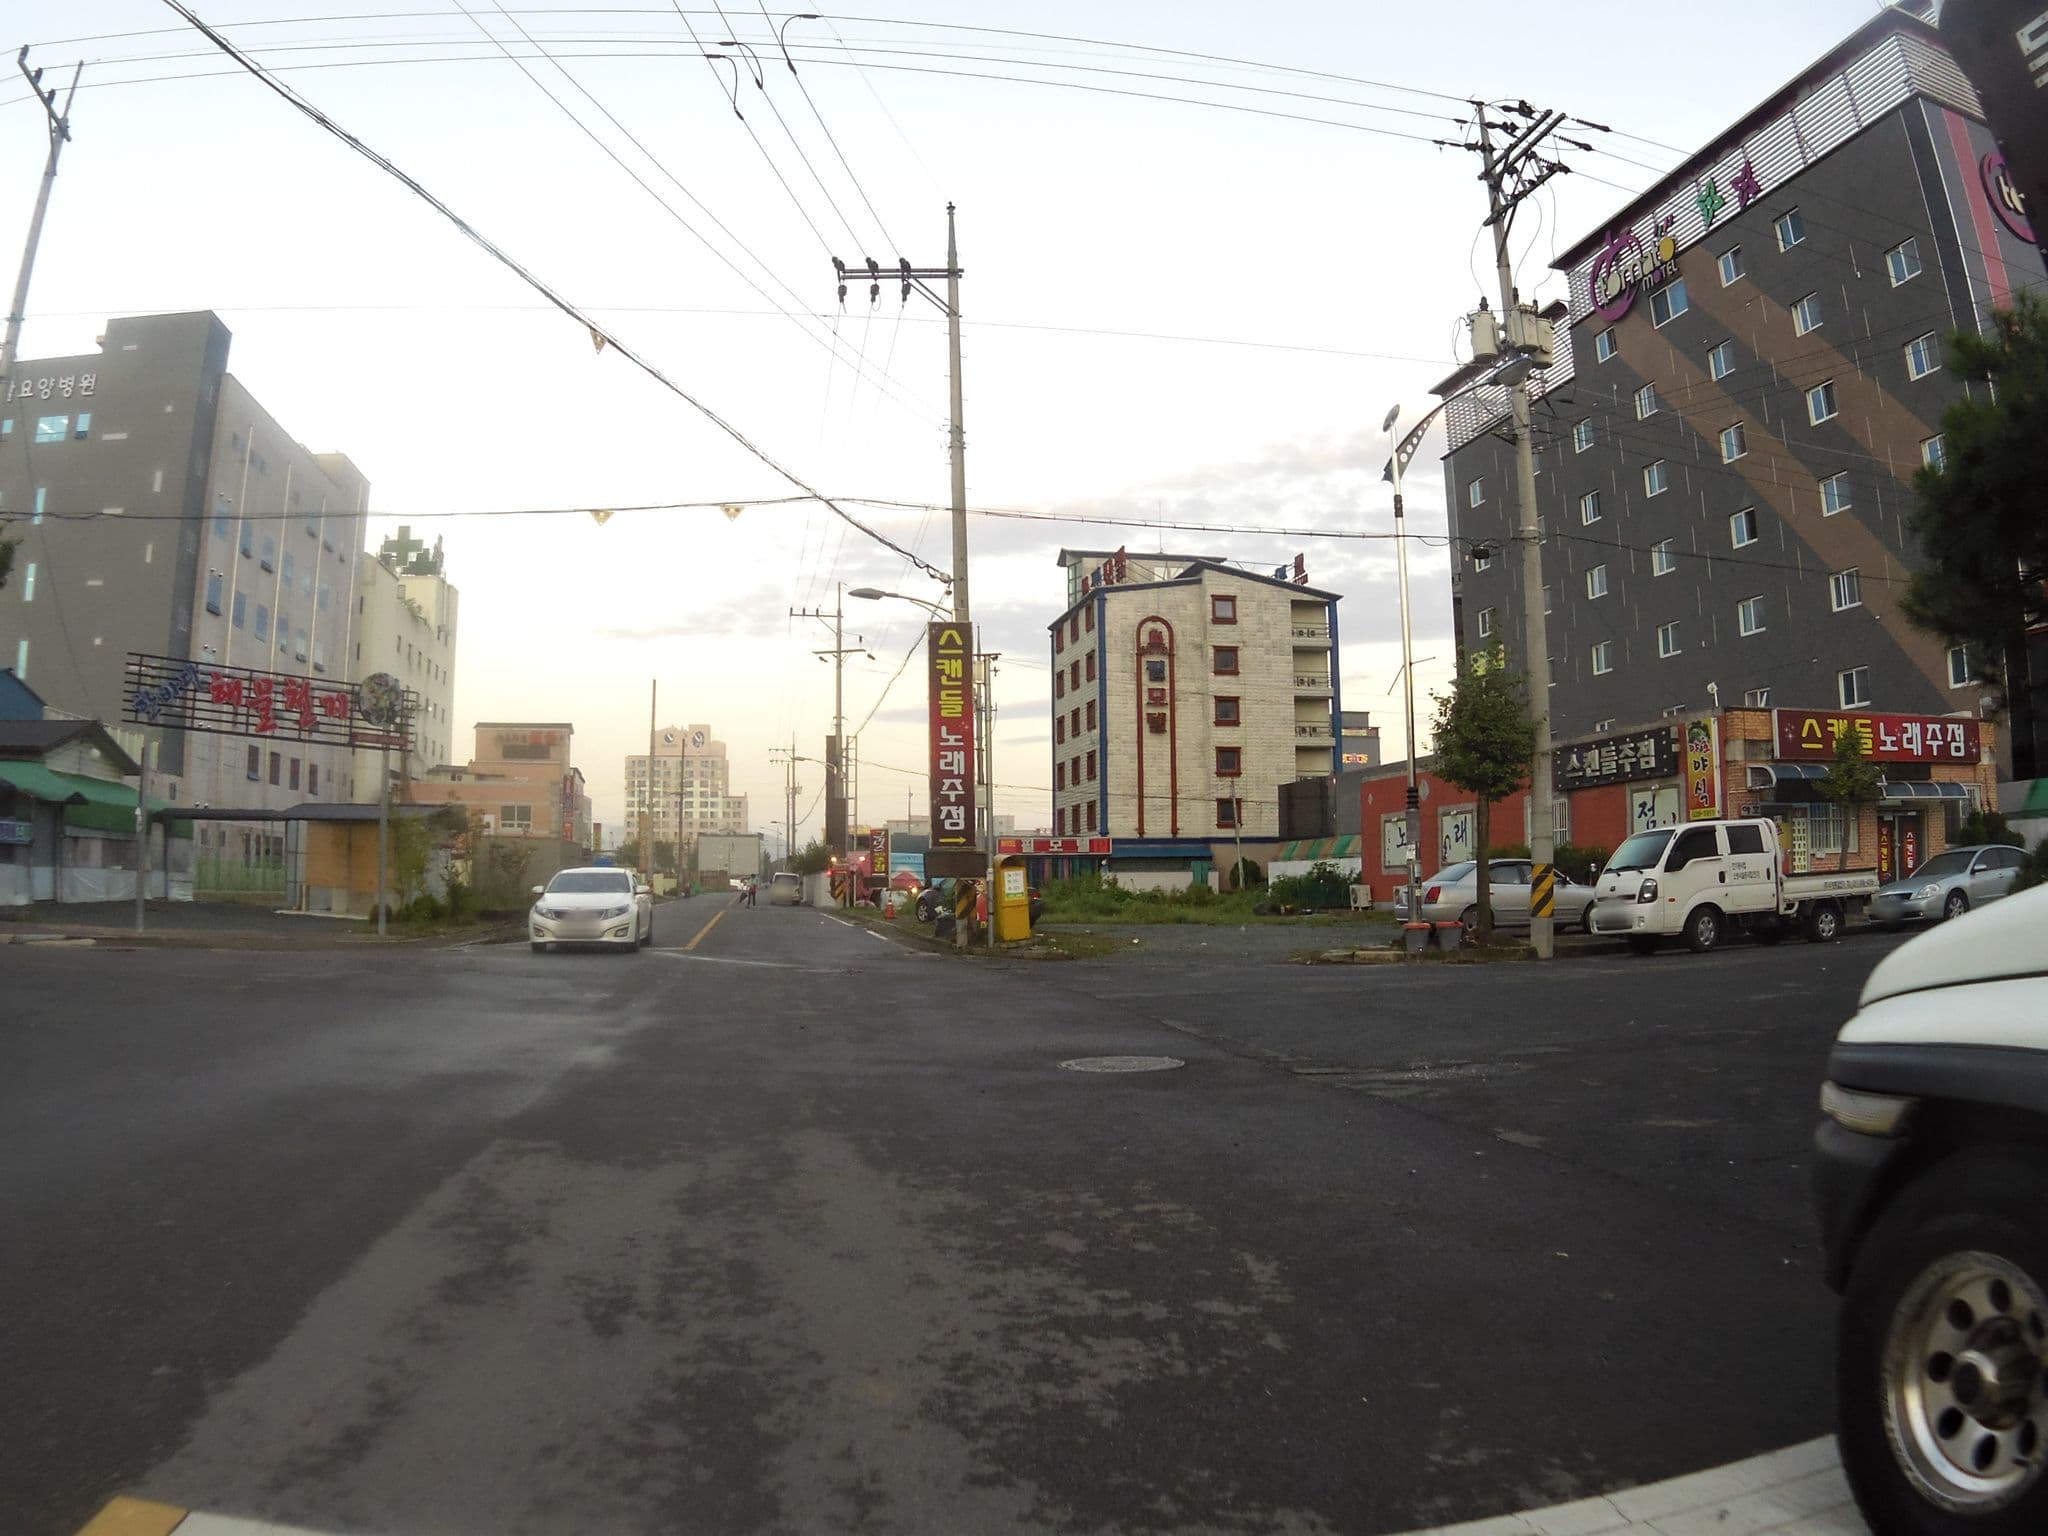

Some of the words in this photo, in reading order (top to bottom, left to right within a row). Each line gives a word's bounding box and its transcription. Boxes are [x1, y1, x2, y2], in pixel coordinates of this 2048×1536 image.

[936, 629, 964, 718] 스캔들
[1801, 718, 1874, 756] 스캔들
[1879, 722, 1966, 758] 노래주점
[938, 725, 965, 830] 노래주점
[1693, 756, 1710, 807] 야식
